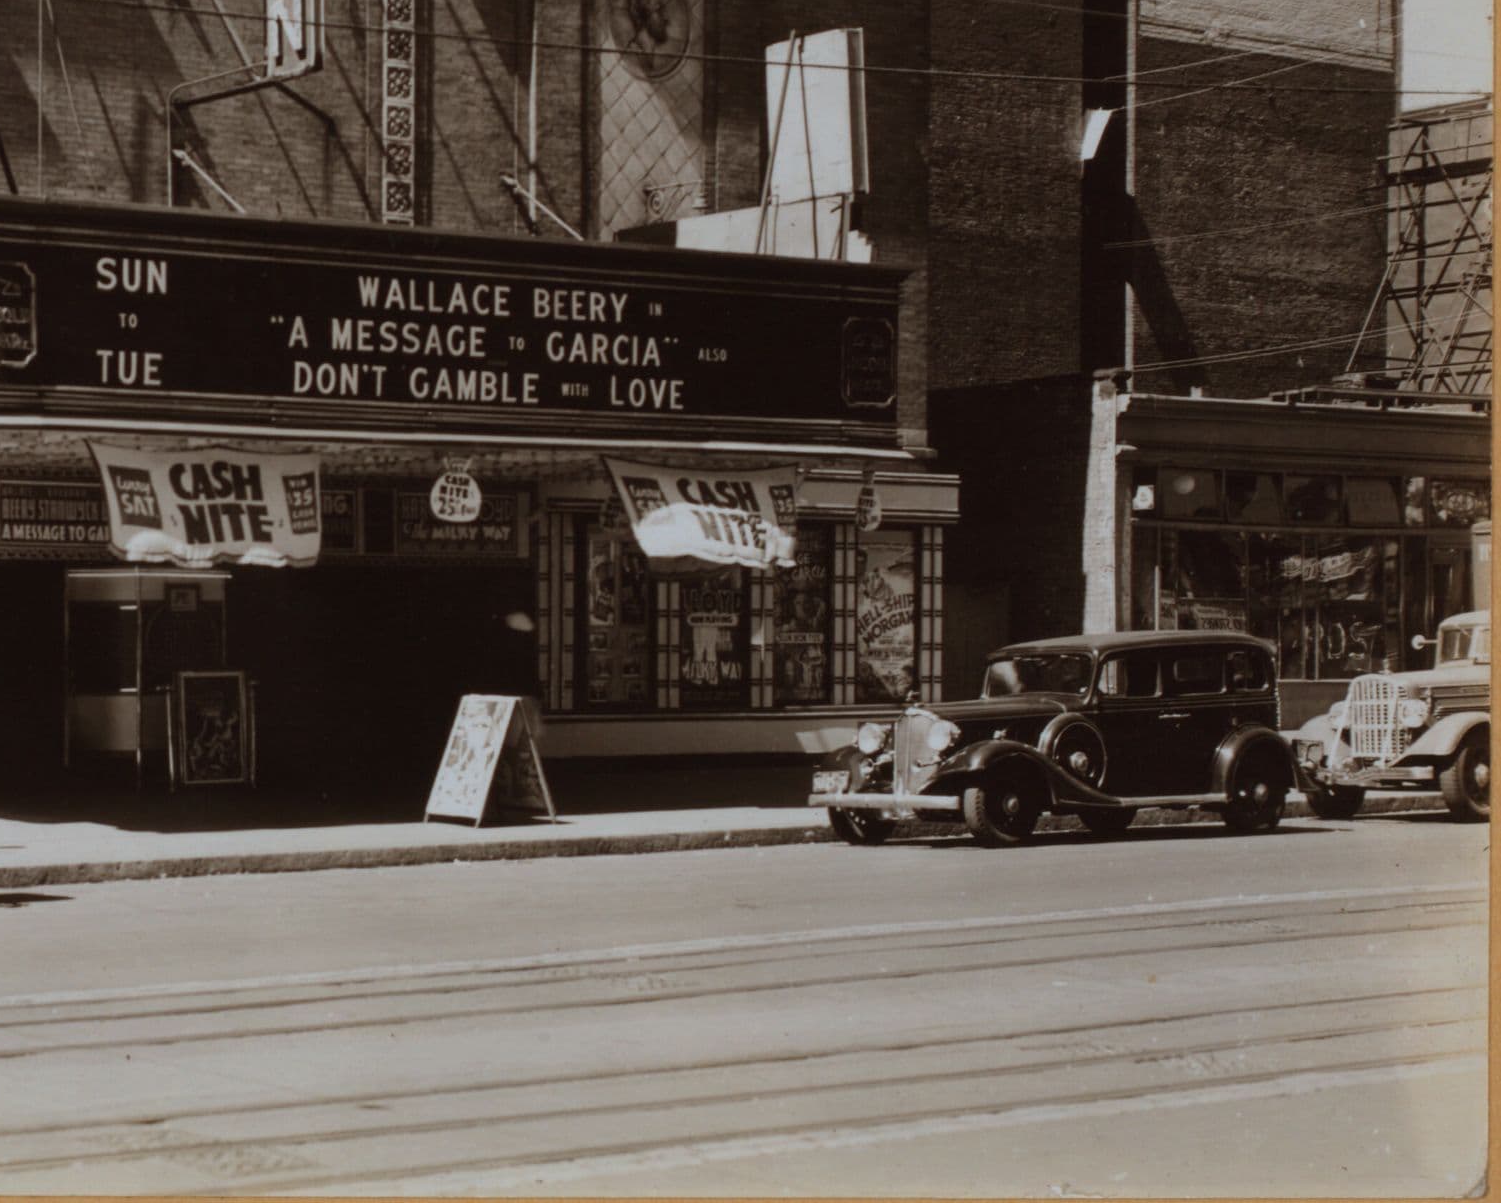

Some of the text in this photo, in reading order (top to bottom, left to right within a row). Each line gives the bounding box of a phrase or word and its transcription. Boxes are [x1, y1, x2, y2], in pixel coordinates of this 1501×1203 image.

[95, 256, 167, 295] SUN
[118, 311, 139, 328] TO
[358, 276, 662, 324] WALLACE BEERY IN
[269, 316, 728, 369] "A MESSAGE TO GARCIA" ALSO
[95, 348, 163, 387] TUE
[293, 361, 685, 410] DON'T GAMBLE WITH LOVE
[168, 461, 263, 501] CASH
[440, 485, 468, 499] NITE
[445, 475, 471, 486] CASH
[676, 477, 760, 513] CASH
[121, 493, 155, 517] SAT
[177, 504, 274, 545] NITE
[2, 523, 12, 540] A
[13, 524, 66, 541] MESSAGE
[68, 525, 85, 541] TO
[690, 508, 767, 549] NITE
